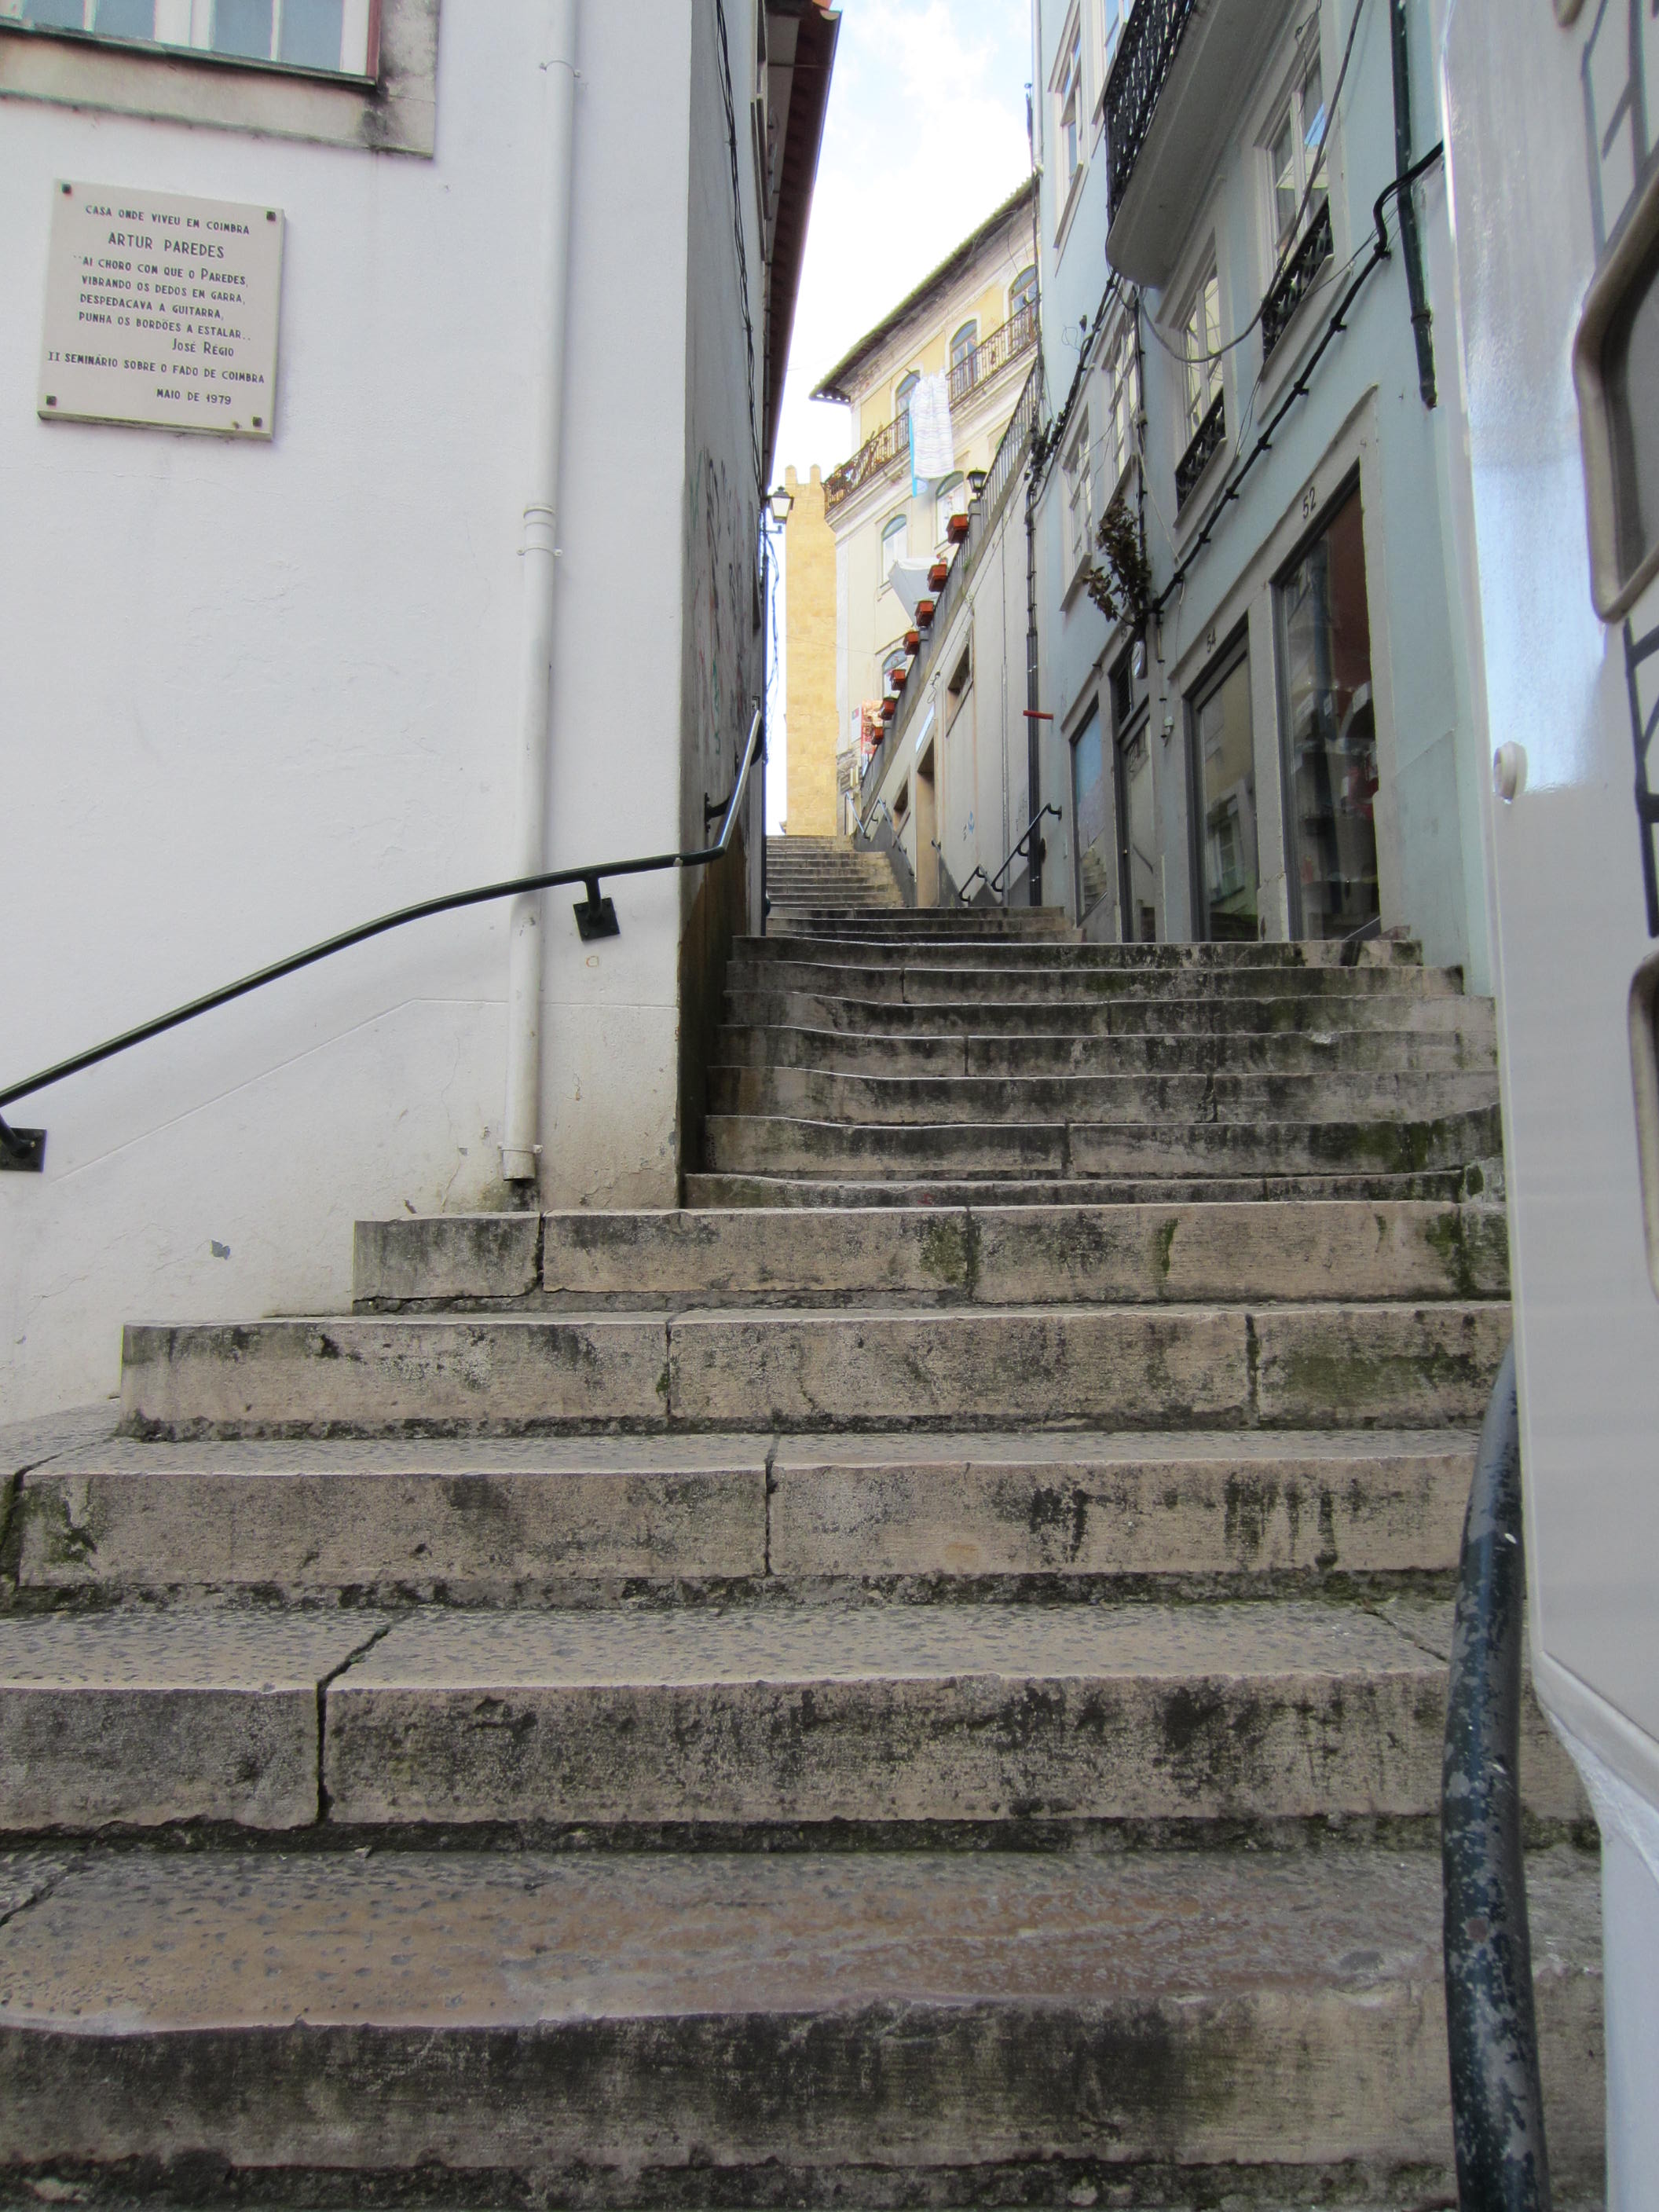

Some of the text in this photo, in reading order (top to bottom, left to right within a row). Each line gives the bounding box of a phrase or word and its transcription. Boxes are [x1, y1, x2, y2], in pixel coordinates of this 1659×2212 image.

[86, 205, 250, 234] CASA ONDE VIVEU EM COIMBRA
[108, 232, 225, 258] ARTUR PAREDES
[98, 258, 132, 271] CHORO
[137, 263, 158, 275] COM
[163, 266, 183, 278] QUE
[82, 275, 132, 290] VIBRANDO
[137, 282, 150, 292] OS
[155, 284, 187, 296] DEDOS
[211, 291, 245, 305] GARRA,
[79, 311, 112, 324] PUNHA
[117, 316, 130, 326] OS
[186, 324, 193, 334] A
[159, 302, 166, 312] A
[172, 304, 224, 320] GUITARRA,
[48, 351, 265, 384] II SEMINÁRIO SOBRE O FADO DE COIMBRA
[156, 388, 232, 405] MAIO DE 1979
[1302, 486, 1316, 519] 52
